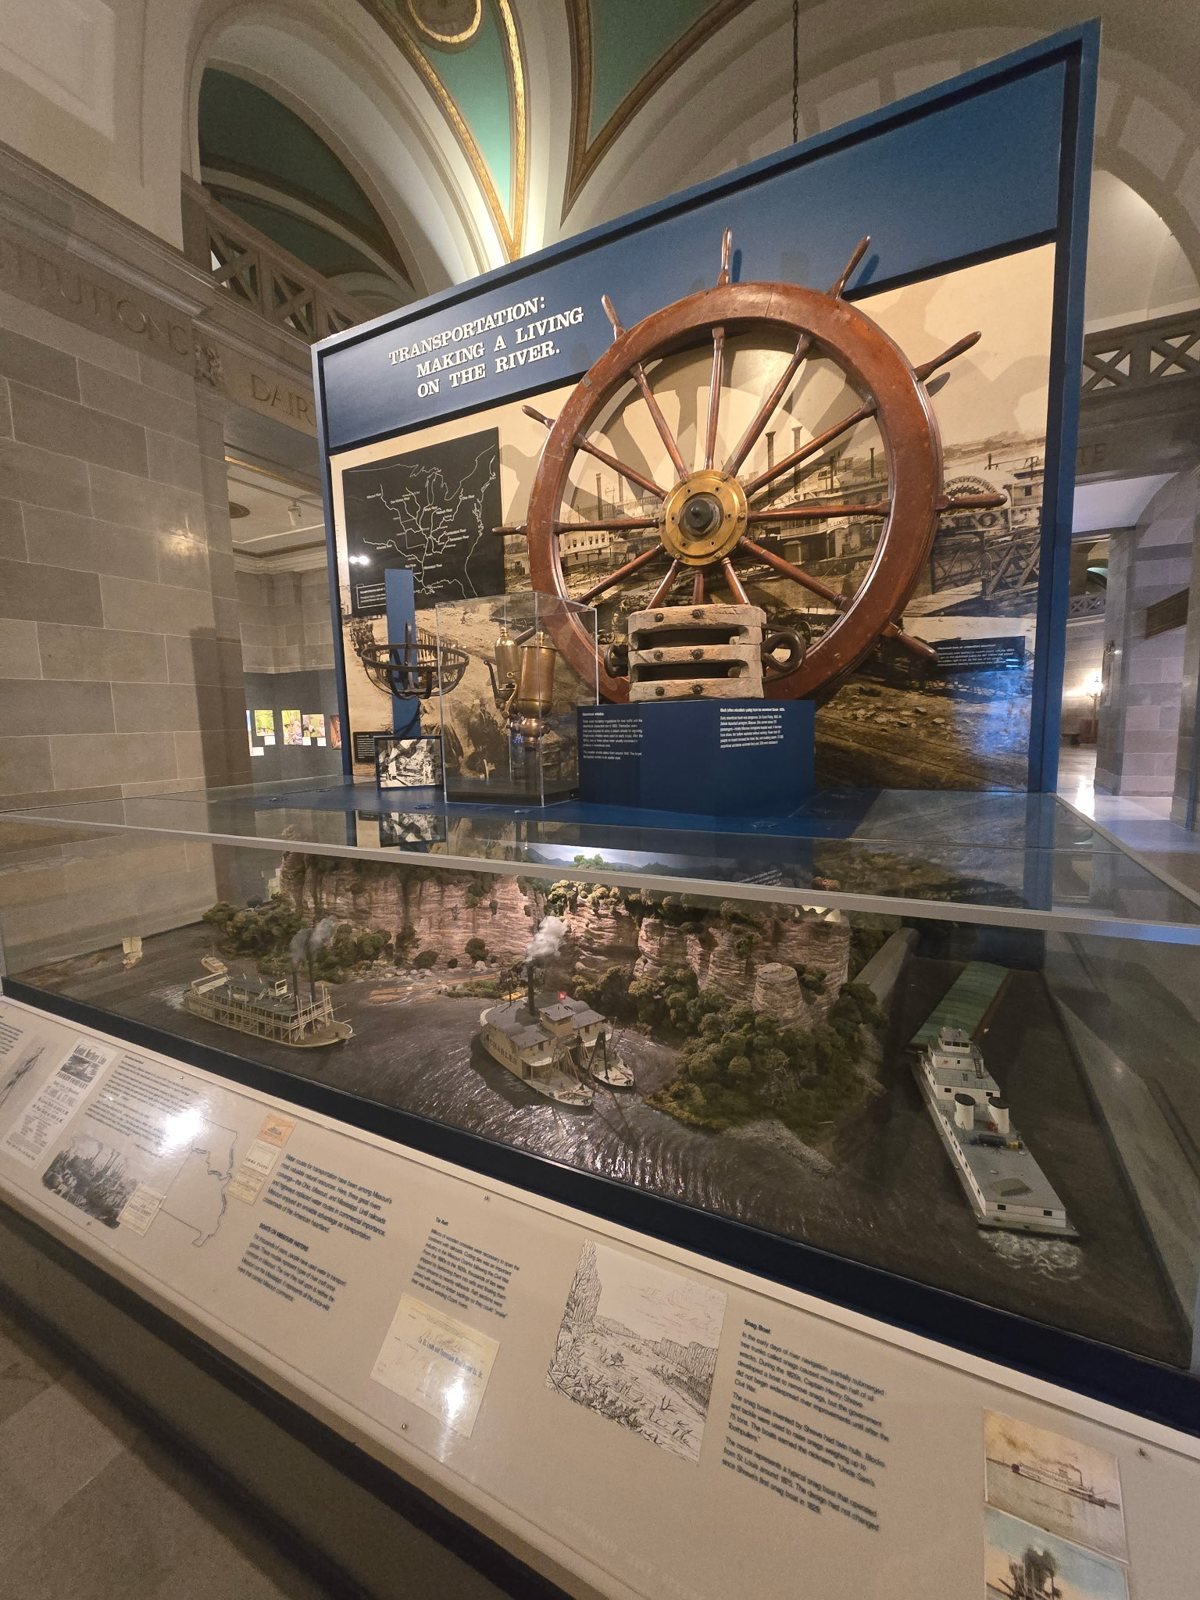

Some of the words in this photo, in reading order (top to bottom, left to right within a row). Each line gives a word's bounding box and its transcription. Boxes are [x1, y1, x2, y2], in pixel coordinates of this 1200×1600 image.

[388, 296, 546, 366] TRANSPORTATION:
[416, 342, 485, 378] MAKING
[493, 335, 507, 352] A
[515, 306, 585, 345] LIVING
[417, 378, 440, 398] ON
[449, 363, 486, 389] THE
[495, 339, 561, 374] RIVER.
